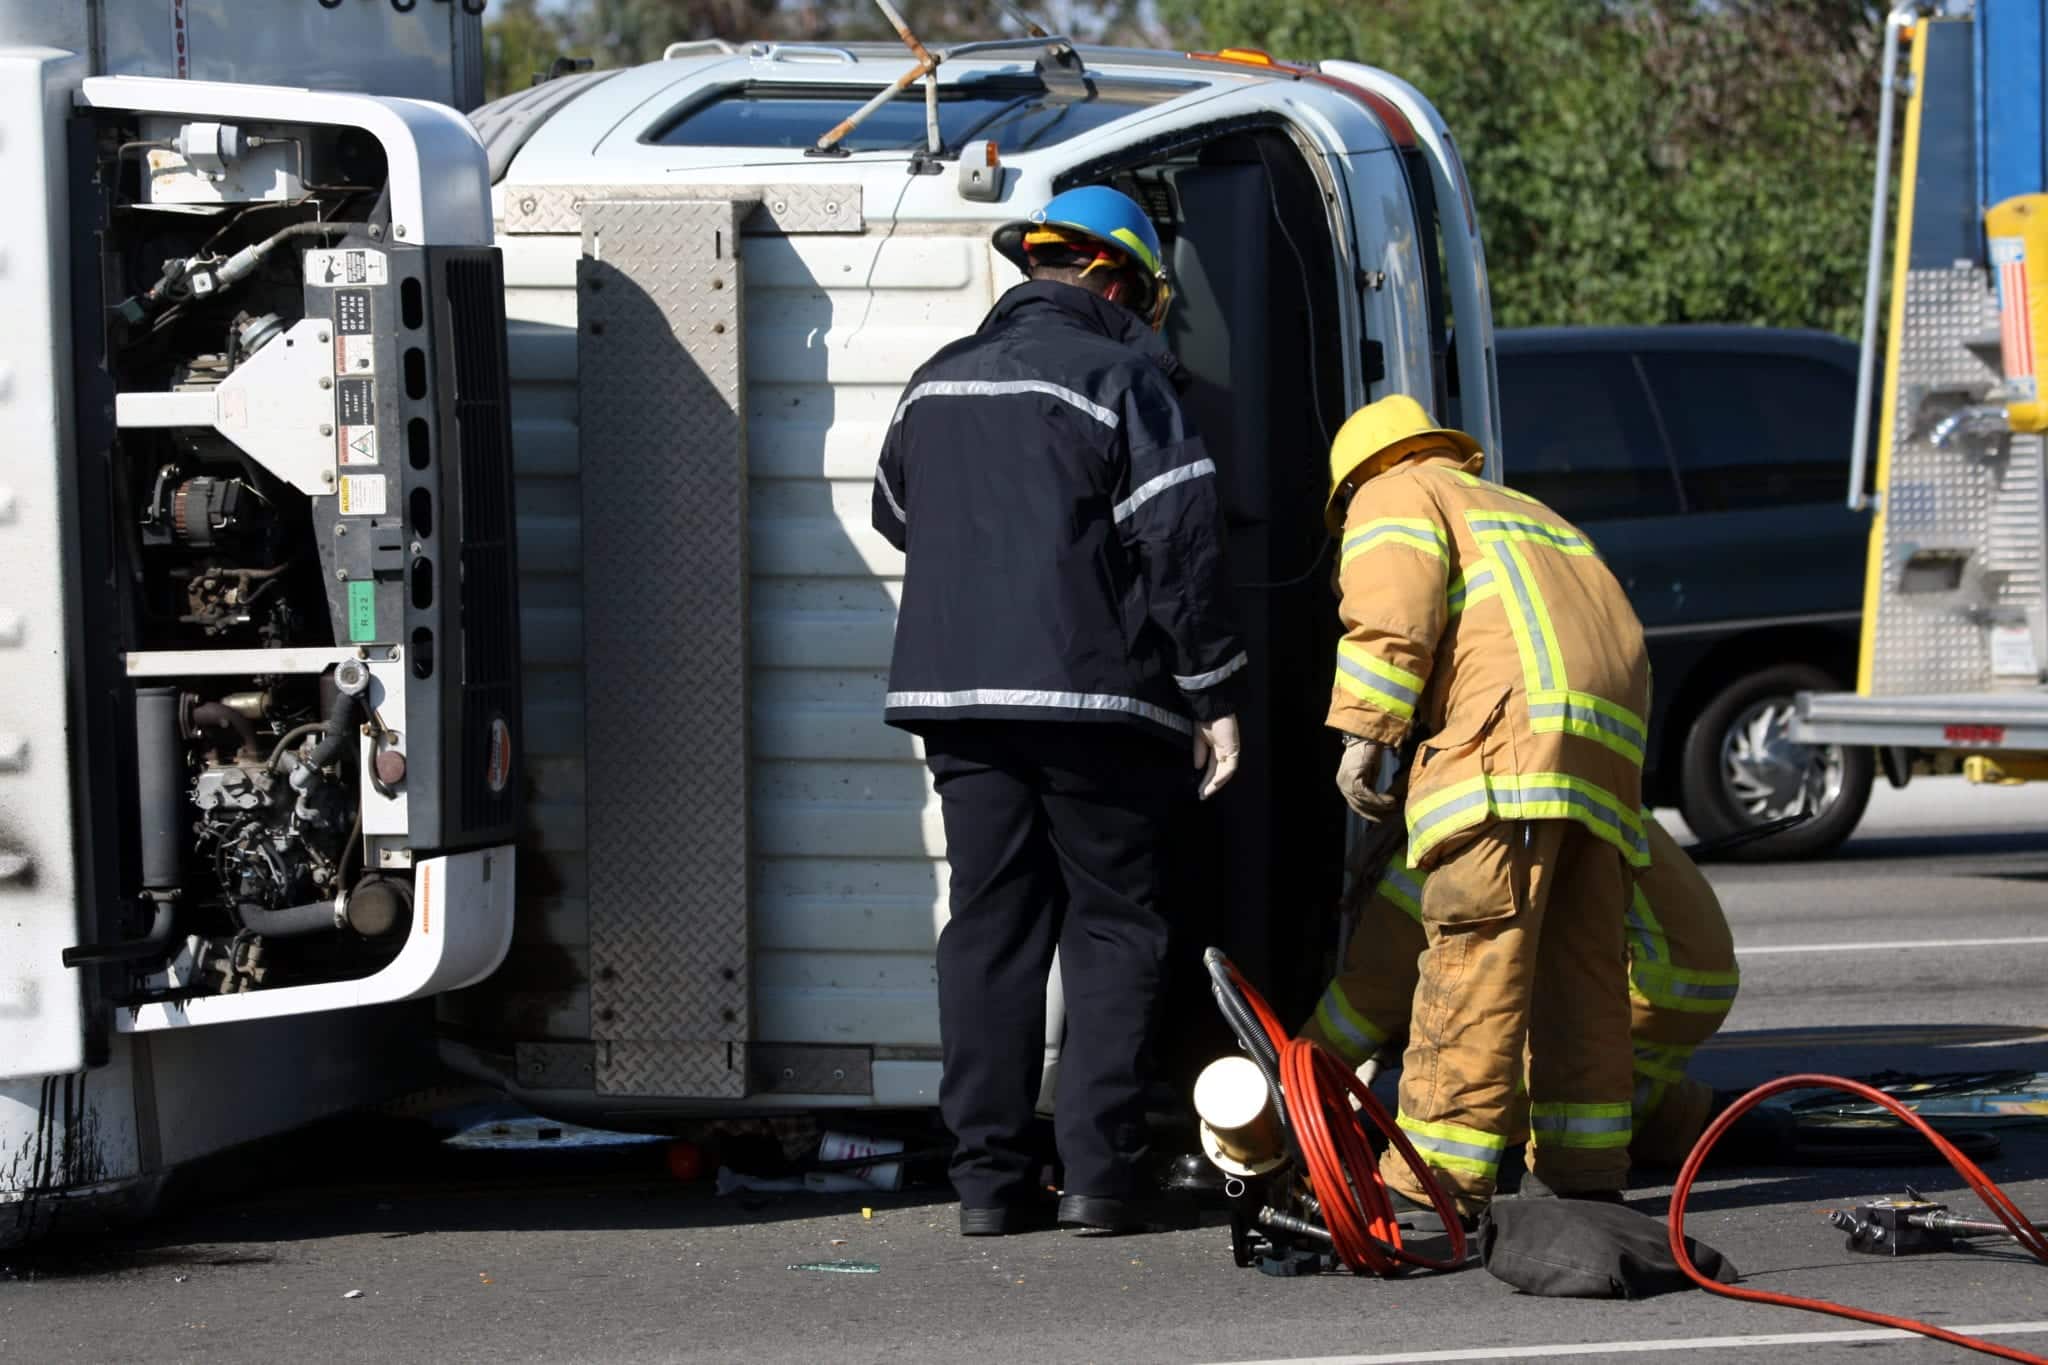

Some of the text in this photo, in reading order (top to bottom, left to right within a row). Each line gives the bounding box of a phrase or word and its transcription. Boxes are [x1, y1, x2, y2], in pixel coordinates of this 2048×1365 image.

[341, 296, 349, 330] BEWARE
[350, 319, 356, 330] OF
[360, 597, 369, 627] R-22
